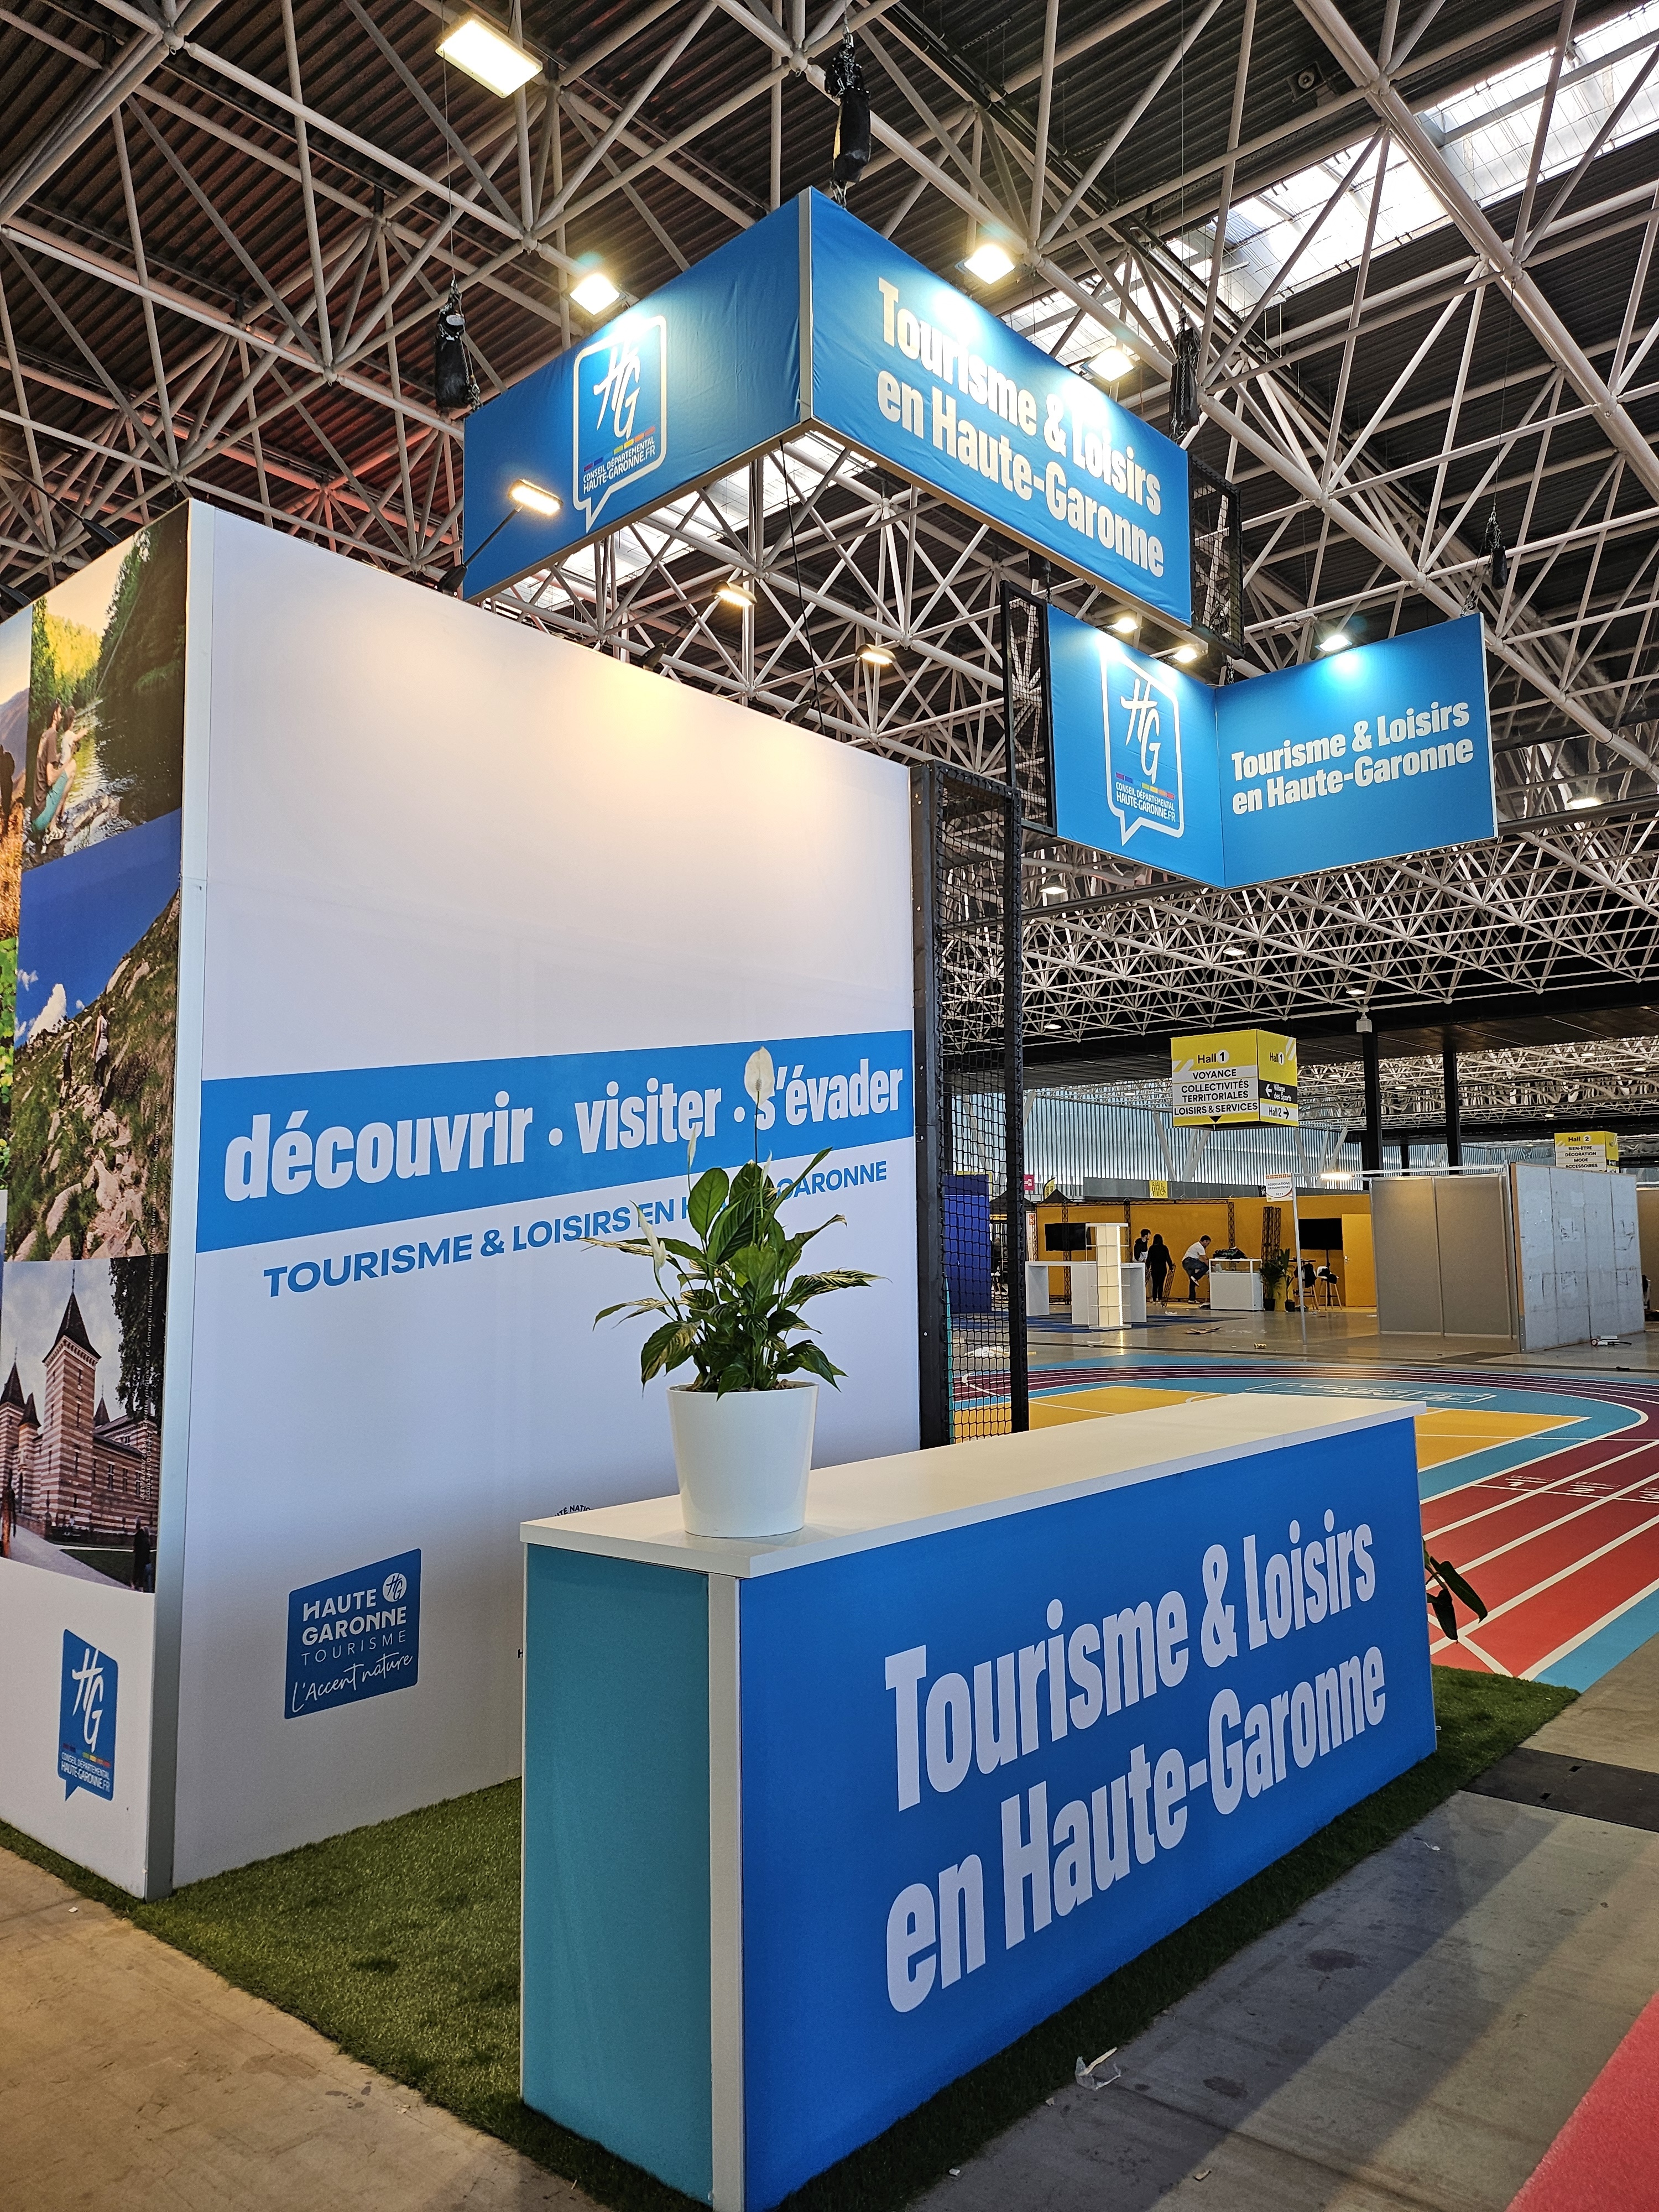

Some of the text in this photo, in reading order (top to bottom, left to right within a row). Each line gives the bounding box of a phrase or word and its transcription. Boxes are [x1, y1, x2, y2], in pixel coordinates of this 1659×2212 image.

[878, 277, 1161, 516] Tourisme & Loisirs
[583, 436, 655, 483] CONSEIL DÉPARTEMENTAL
[583, 446, 656, 494] HAUTE-GARONNE.FR
[877, 370, 1164, 577] en Haute-Garonne
[1231, 702, 1470, 781] Tourisme & Loisirs
[1232, 738, 1474, 815] en Haute-Garonne
[1115, 781, 1175, 811] CONSEIL DÉPARTEMENTAL
[1116, 791, 1176, 823] HAUTE-GARONNE.FR
[1192, 1068, 1237, 1080] VOYANCE
[1197, 1052, 1225, 1064] Hall 1
[1181, 1079, 1249, 1093] COLLECTIVITÉS
[1182, 1091, 1249, 1103] TERRITORIALES
[1174, 1102, 1258, 1116] LOISIRS & SERVICES
[1278, 1107, 1282, 1117] 2
[224, 1091, 533, 1202] découvrir
[575, 1077, 722, 1154] visiter
[264, 1234, 472, 1298] TOURISME
[480, 1229, 504, 1257] &
[513, 1206, 631, 1252] LOISIRS
[638, 1198, 674, 1225] EN
[303, 1588, 377, 1622] HAUTE
[302, 1606, 407, 1646] GARONNE
[301, 1630, 406, 1666] TOURISME
[885, 1509, 1375, 1812] Tourisme & Loisirs
[362, 1652, 413, 1683] nature
[61, 1751, 76, 1766] CONSEIL
[886, 1646, 1386, 2012] en Haute-Garonne
